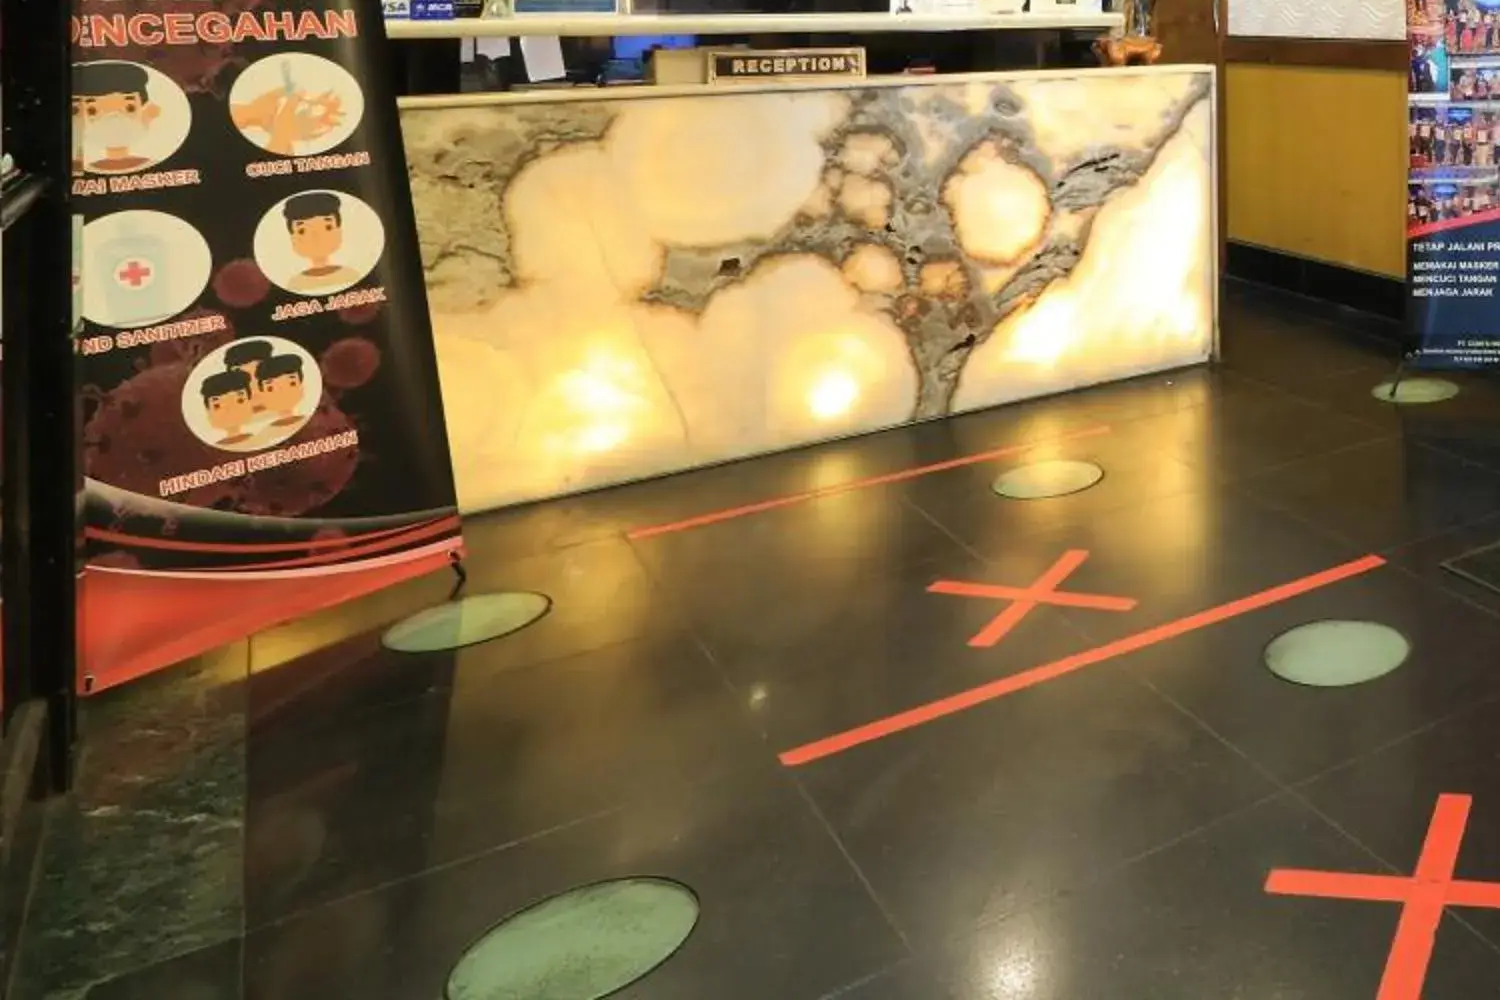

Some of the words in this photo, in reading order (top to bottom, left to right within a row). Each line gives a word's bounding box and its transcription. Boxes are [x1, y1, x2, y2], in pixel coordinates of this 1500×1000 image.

[72, 9, 357, 47] NCEGAHAN
[732, 56, 846, 74] RECEPTION
[109, 169, 202, 193] MASKER
[1458, 274, 1498, 283] TANGAN
[1461, 287, 1494, 297] JARAK
[271, 298, 324, 322] JAGA
[324, 286, 387, 311] JARAK
[116, 315, 227, 350] SANITIZER
[160, 459, 247, 497] HINDARI
